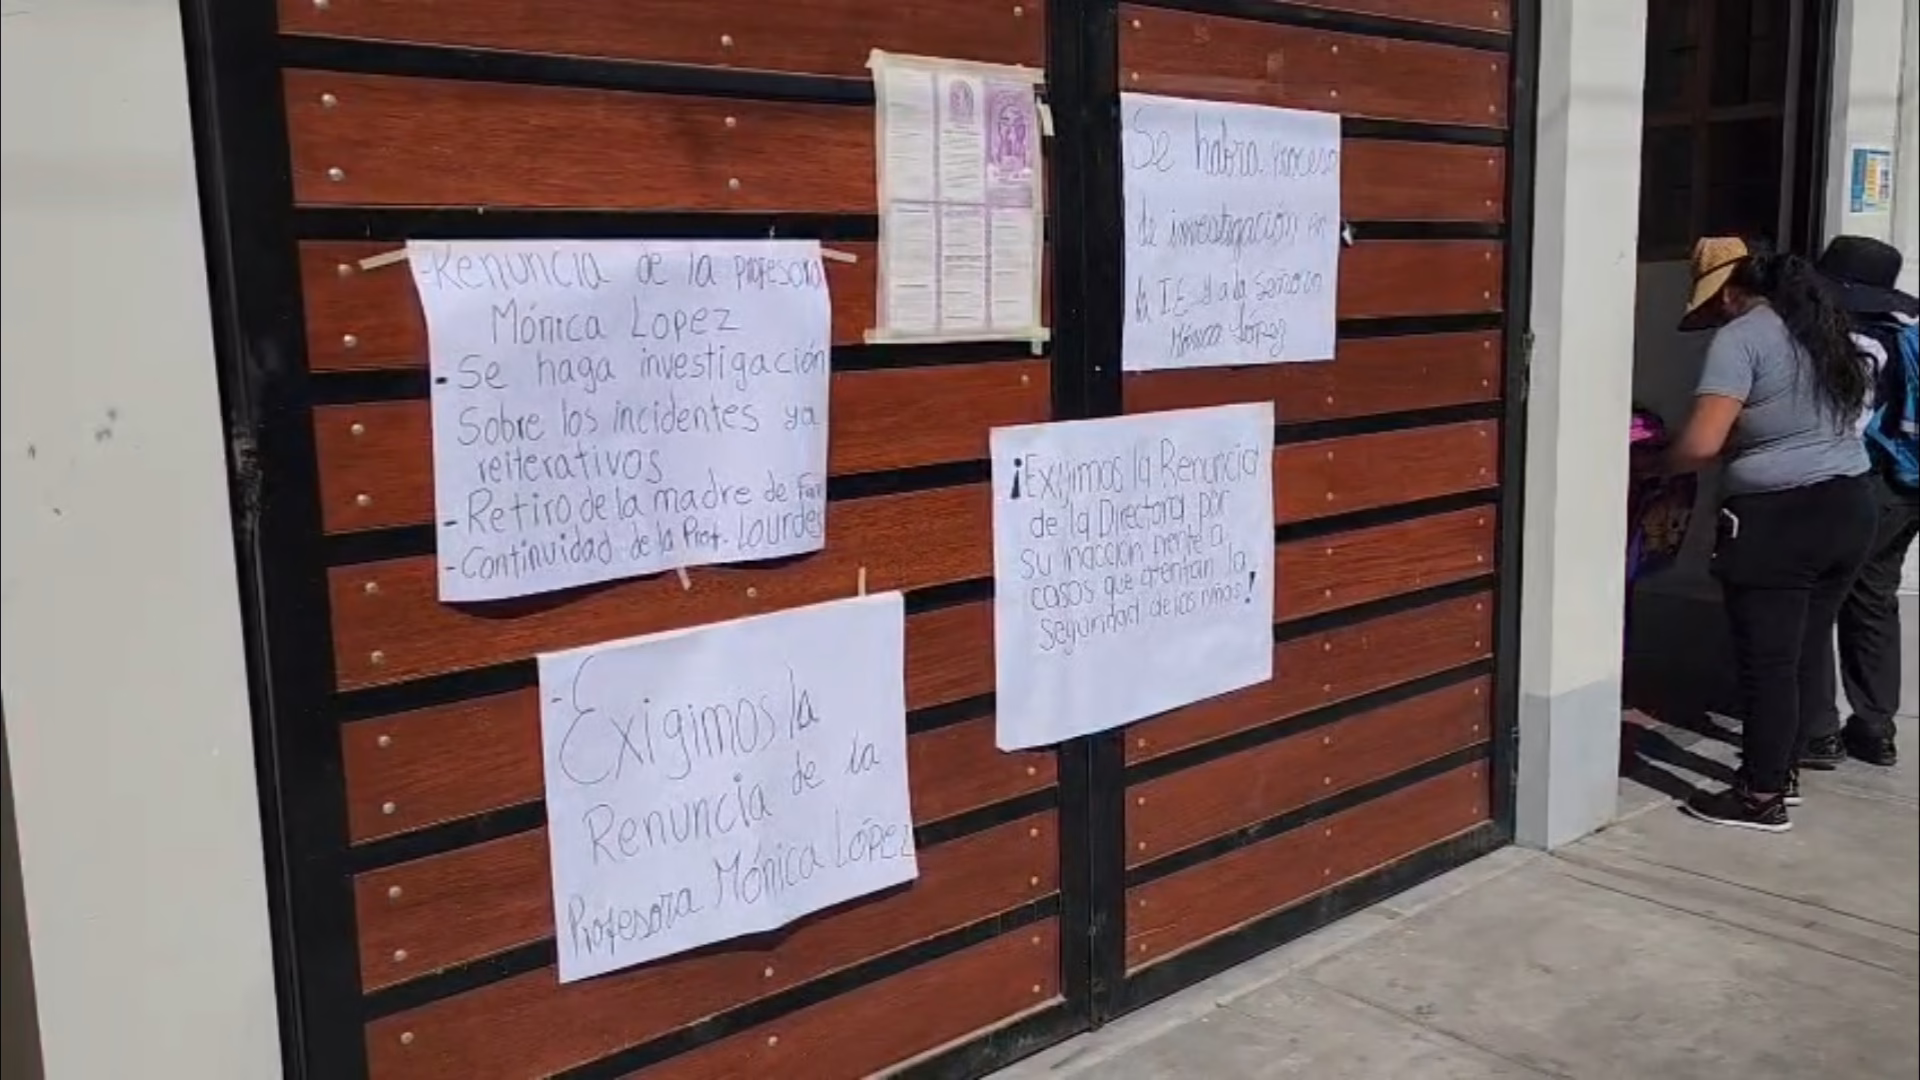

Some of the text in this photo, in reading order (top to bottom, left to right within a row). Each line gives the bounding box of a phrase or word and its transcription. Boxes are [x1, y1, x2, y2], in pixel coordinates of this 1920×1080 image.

[1133, 107, 1174, 172] Se
[638, 251, 667, 285] de
[689, 251, 714, 285] la
[492, 296, 740, 344] Mónica Lopez
[536, 350, 616, 393] haga
[641, 339, 826, 391] investigación
[458, 398, 821, 446] Sobre los incidentes ya
[477, 444, 663, 485] reiterativos
[1133, 443, 1151, 490] la
[1160, 438, 1258, 488] Renuncia
[579, 483, 610, 527] de
[615, 485, 643, 517] la
[653, 467, 754, 514] madre
[763, 469, 788, 503] de
[629, 527, 650, 558] de
[656, 521, 674, 552] la
[1029, 508, 1059, 539] de
[1070, 503, 1091, 540] la
[1209, 523, 1223, 547] a
[1030, 580, 1095, 612] casos
[1103, 573, 1134, 601] que
[1149, 595, 1171, 618] de
[786, 664, 820, 739] la
[582, 731, 881, 867] Renuncia de la
[565, 806, 917, 957] Profesora Mónica López
